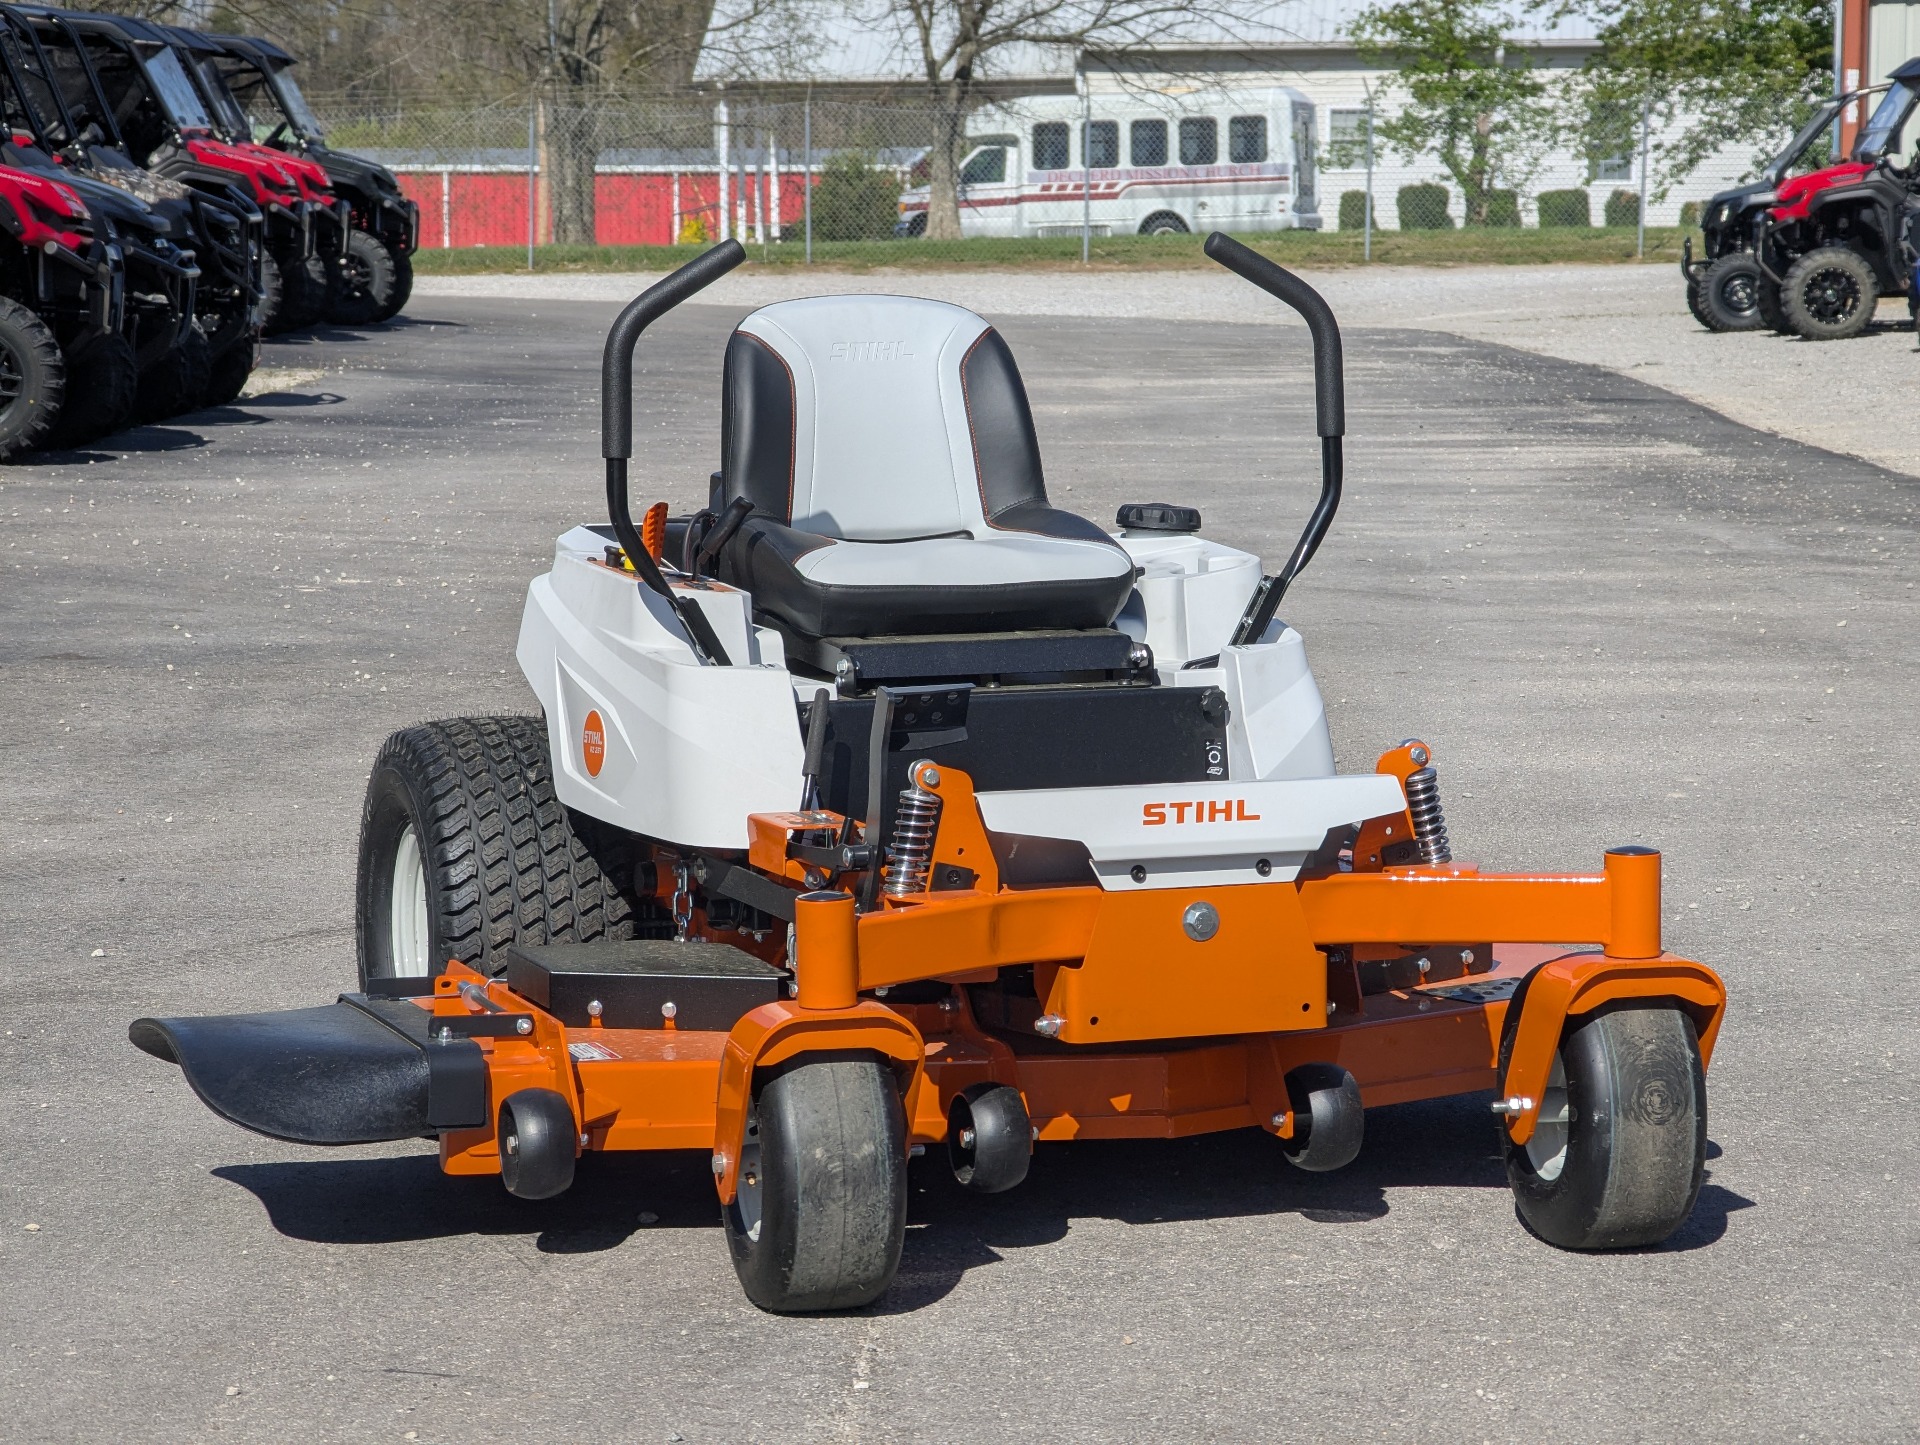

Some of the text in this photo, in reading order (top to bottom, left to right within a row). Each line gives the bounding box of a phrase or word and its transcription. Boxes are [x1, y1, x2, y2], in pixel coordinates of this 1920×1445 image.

[1127, 167, 1189, 180] MISSION
[1195, 164, 1261, 178] CHURCH
[830, 340, 916, 362] STIHL
[583, 730, 603, 745] STIHL
[1142, 799, 1261, 826] STIHL
